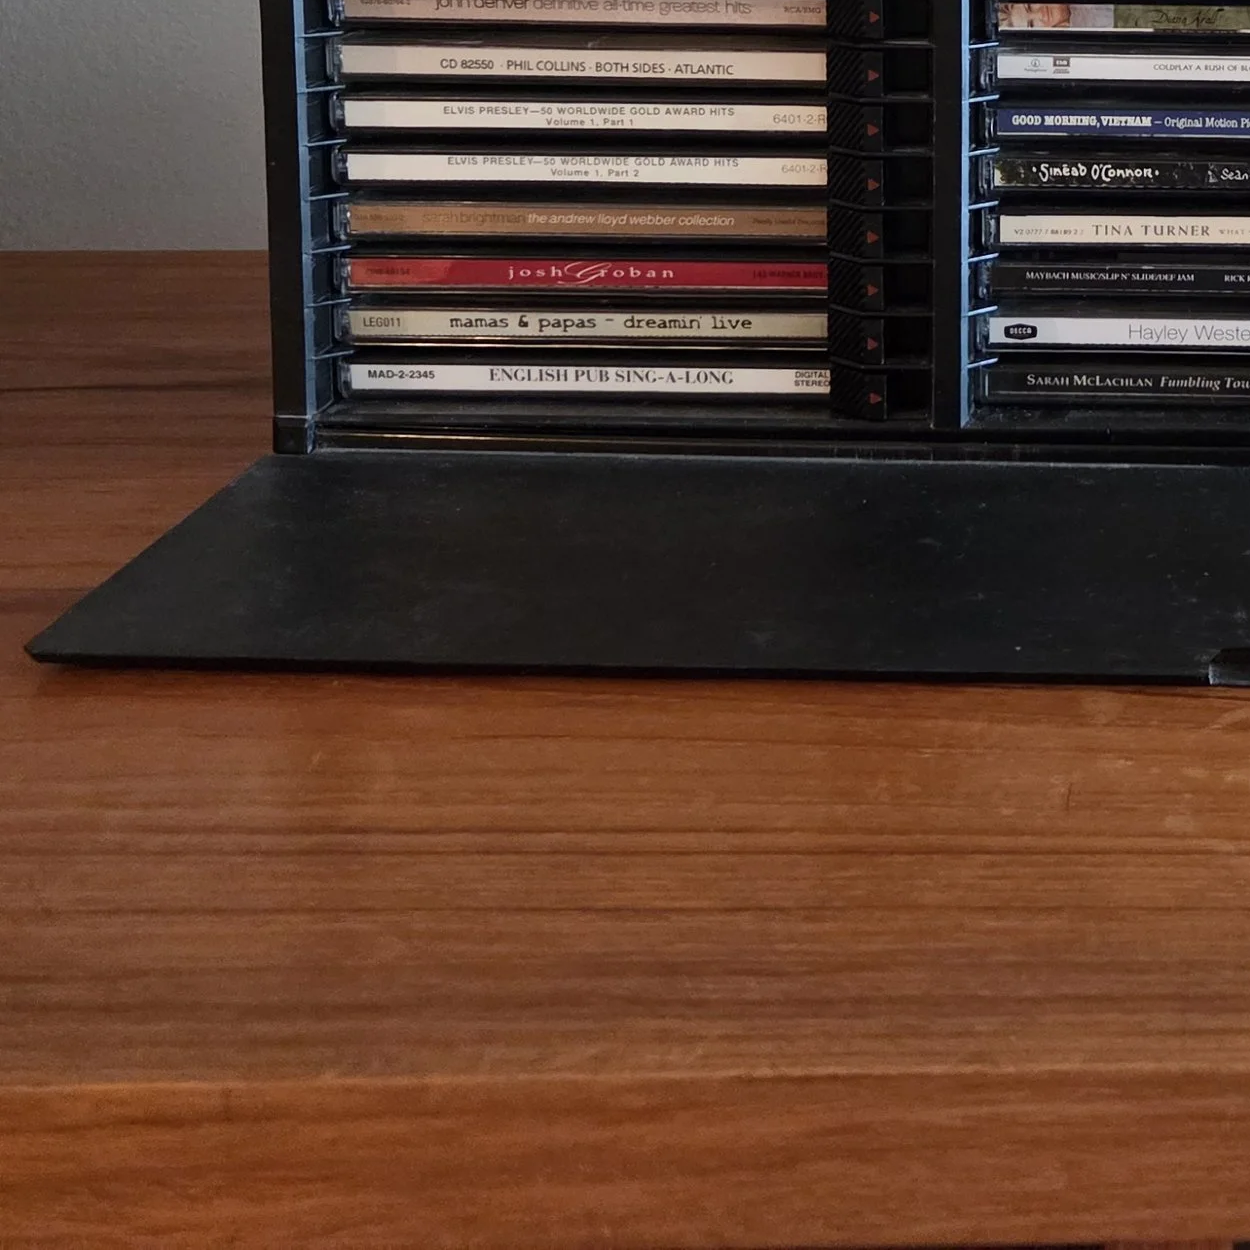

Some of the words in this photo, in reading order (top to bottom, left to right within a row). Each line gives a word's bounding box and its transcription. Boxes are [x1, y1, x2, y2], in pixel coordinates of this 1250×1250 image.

[659, 0, 720, 15] greatest
[725, 0, 751, 14] hits
[440, 58, 458, 69] CD
[461, 59, 494, 70] 82550
[507, 60, 534, 71] PHIL
[536, 60, 586, 72] COLLINS
[595, 62, 629, 73] BOTH
[632, 62, 665, 74] SIDES
[674, 64, 734, 75] ATLANTIC
[1153, 63, 1193, 71] COLDPLAY
[443, 106, 475, 115] ELVIS
[557, 107, 626, 116] WORLDWIDE
[630, 107, 660, 116] GOLD
[665, 107, 705, 116] AWARD
[710, 108, 735, 116] HITS
[546, 118, 585, 126] Volume
[603, 118, 625, 127] Part
[629, 119, 634, 127] 1
[772, 114, 827, 125] 6401-2-R
[1012, 115, 1041, 126] GOOD
[1044, 115, 1100, 128] MORNING,
[1101, 116, 1152, 127] VIETNAM
[1164, 116, 1203, 129] Original
[1205, 117, 1238, 129] Motion
[447, 157, 478, 166] ELVIS
[560, 157, 629, 167] WORLDWIDE
[634, 157, 665, 167] GOLD
[670, 158, 710, 167] AWARD
[714, 158, 739, 167] HITS
[551, 168, 590, 177] Volume
[608, 169, 630, 178] Part
[634, 169, 639, 177] 2
[527, 213, 547, 224] the
[549, 213, 594, 224] andrew
[598, 213, 627, 227] lloyd
[630, 215, 676, 226] webber
[679, 214, 735, 226] collection
[1092, 224, 1133, 236] TINA
[1141, 224, 1210, 237] TURNER
[508, 266, 562, 280] josh
[1026, 271, 1069, 280] MAYBACH
[1177, 274, 1195, 282] JAM
[1224, 274, 1245, 283] RICK
[363, 317, 400, 328] LEG011
[450, 317, 509, 328] mamas
[518, 315, 528, 328] &
[538, 317, 596, 332] papas
[712, 316, 753, 330] live
[1009, 326, 1032, 335] DECCA
[1128, 324, 1188, 343] Hayley
[368, 370, 436, 379] MAD-2-2345
[489, 368, 568, 383] ENGLISH
[574, 368, 610, 383] PUB
[615, 369, 733, 385] SING-A-LONG
[795, 371, 829, 379] DIGITAL
[1027, 374, 1069, 386] SARAH
[1160, 376, 1221, 391] Fumbling
